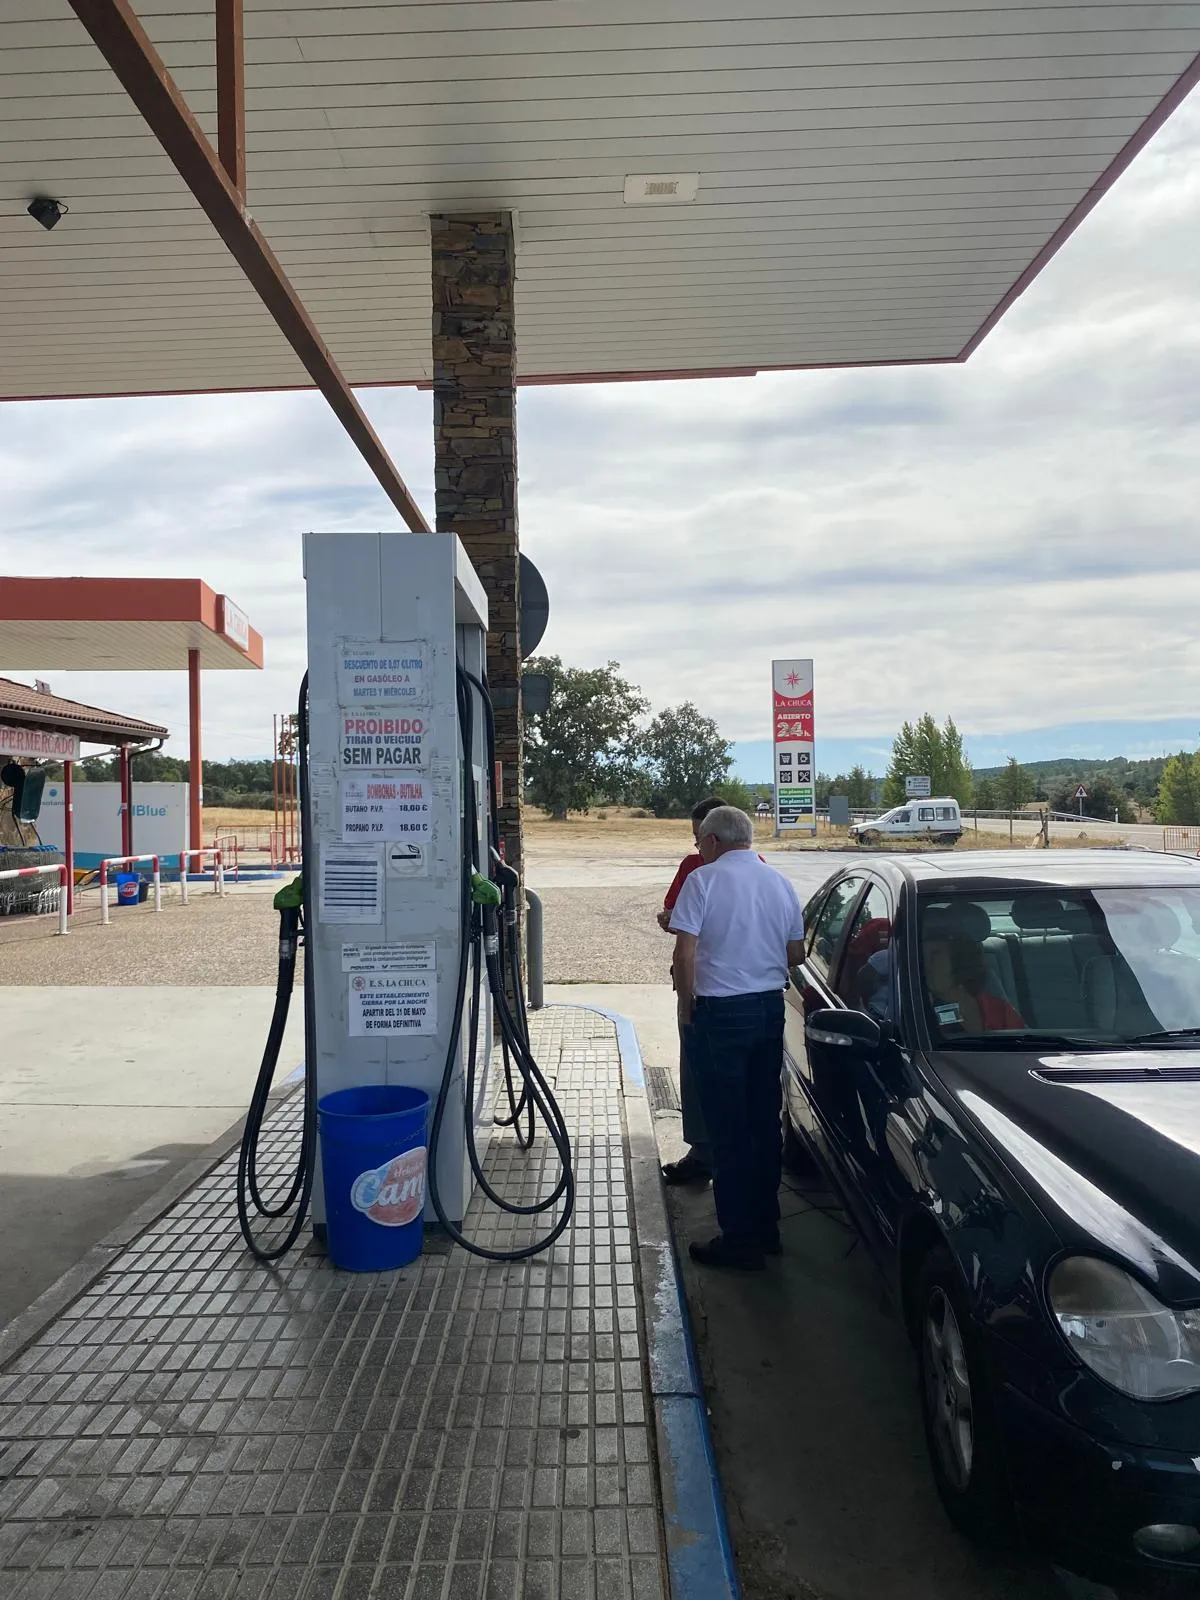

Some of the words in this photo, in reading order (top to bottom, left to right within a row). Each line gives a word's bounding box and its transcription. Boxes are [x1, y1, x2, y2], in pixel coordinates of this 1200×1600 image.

[344, 660, 378, 670] DESCUENTO
[380, 660, 388, 670] DE
[354, 675, 365, 683] EN
[367, 674, 402, 683] GASÓLEO
[404, 675, 410, 683] A
[354, 688, 377, 696] MARTES
[384, 687, 416, 696] MIÉRCOLES
[344, 719, 424, 735] PROIBIDO
[0, 729, 74, 755] PERMERCADO
[346, 736, 373, 744] TIRAR
[375, 736, 382, 744] O
[384, 736, 422, 744] VEICULO
[343, 747, 372, 765] SEM
[376, 747, 422, 765] PAGAR
[345, 805, 368, 813] BUTANO
[421, 804, 428, 812] €
[345, 824, 369, 832] PROPANO
[422, 823, 428, 832] €
[386, 979, 396, 987] LA
[398, 979, 426, 987] CHUCA
[362, 1008, 384, 1017] APARTIR
[385, 1008, 395, 1017] DEL
[403, 1008, 411, 1016] DE
[411, 1007, 427, 1016] MAYO
[366, 1020, 373, 1029] DE
[373, 1020, 392, 1029] FORMA
[393, 1019, 421, 1028] DEFINITIVA
[354, 1170, 425, 1208] Cam
